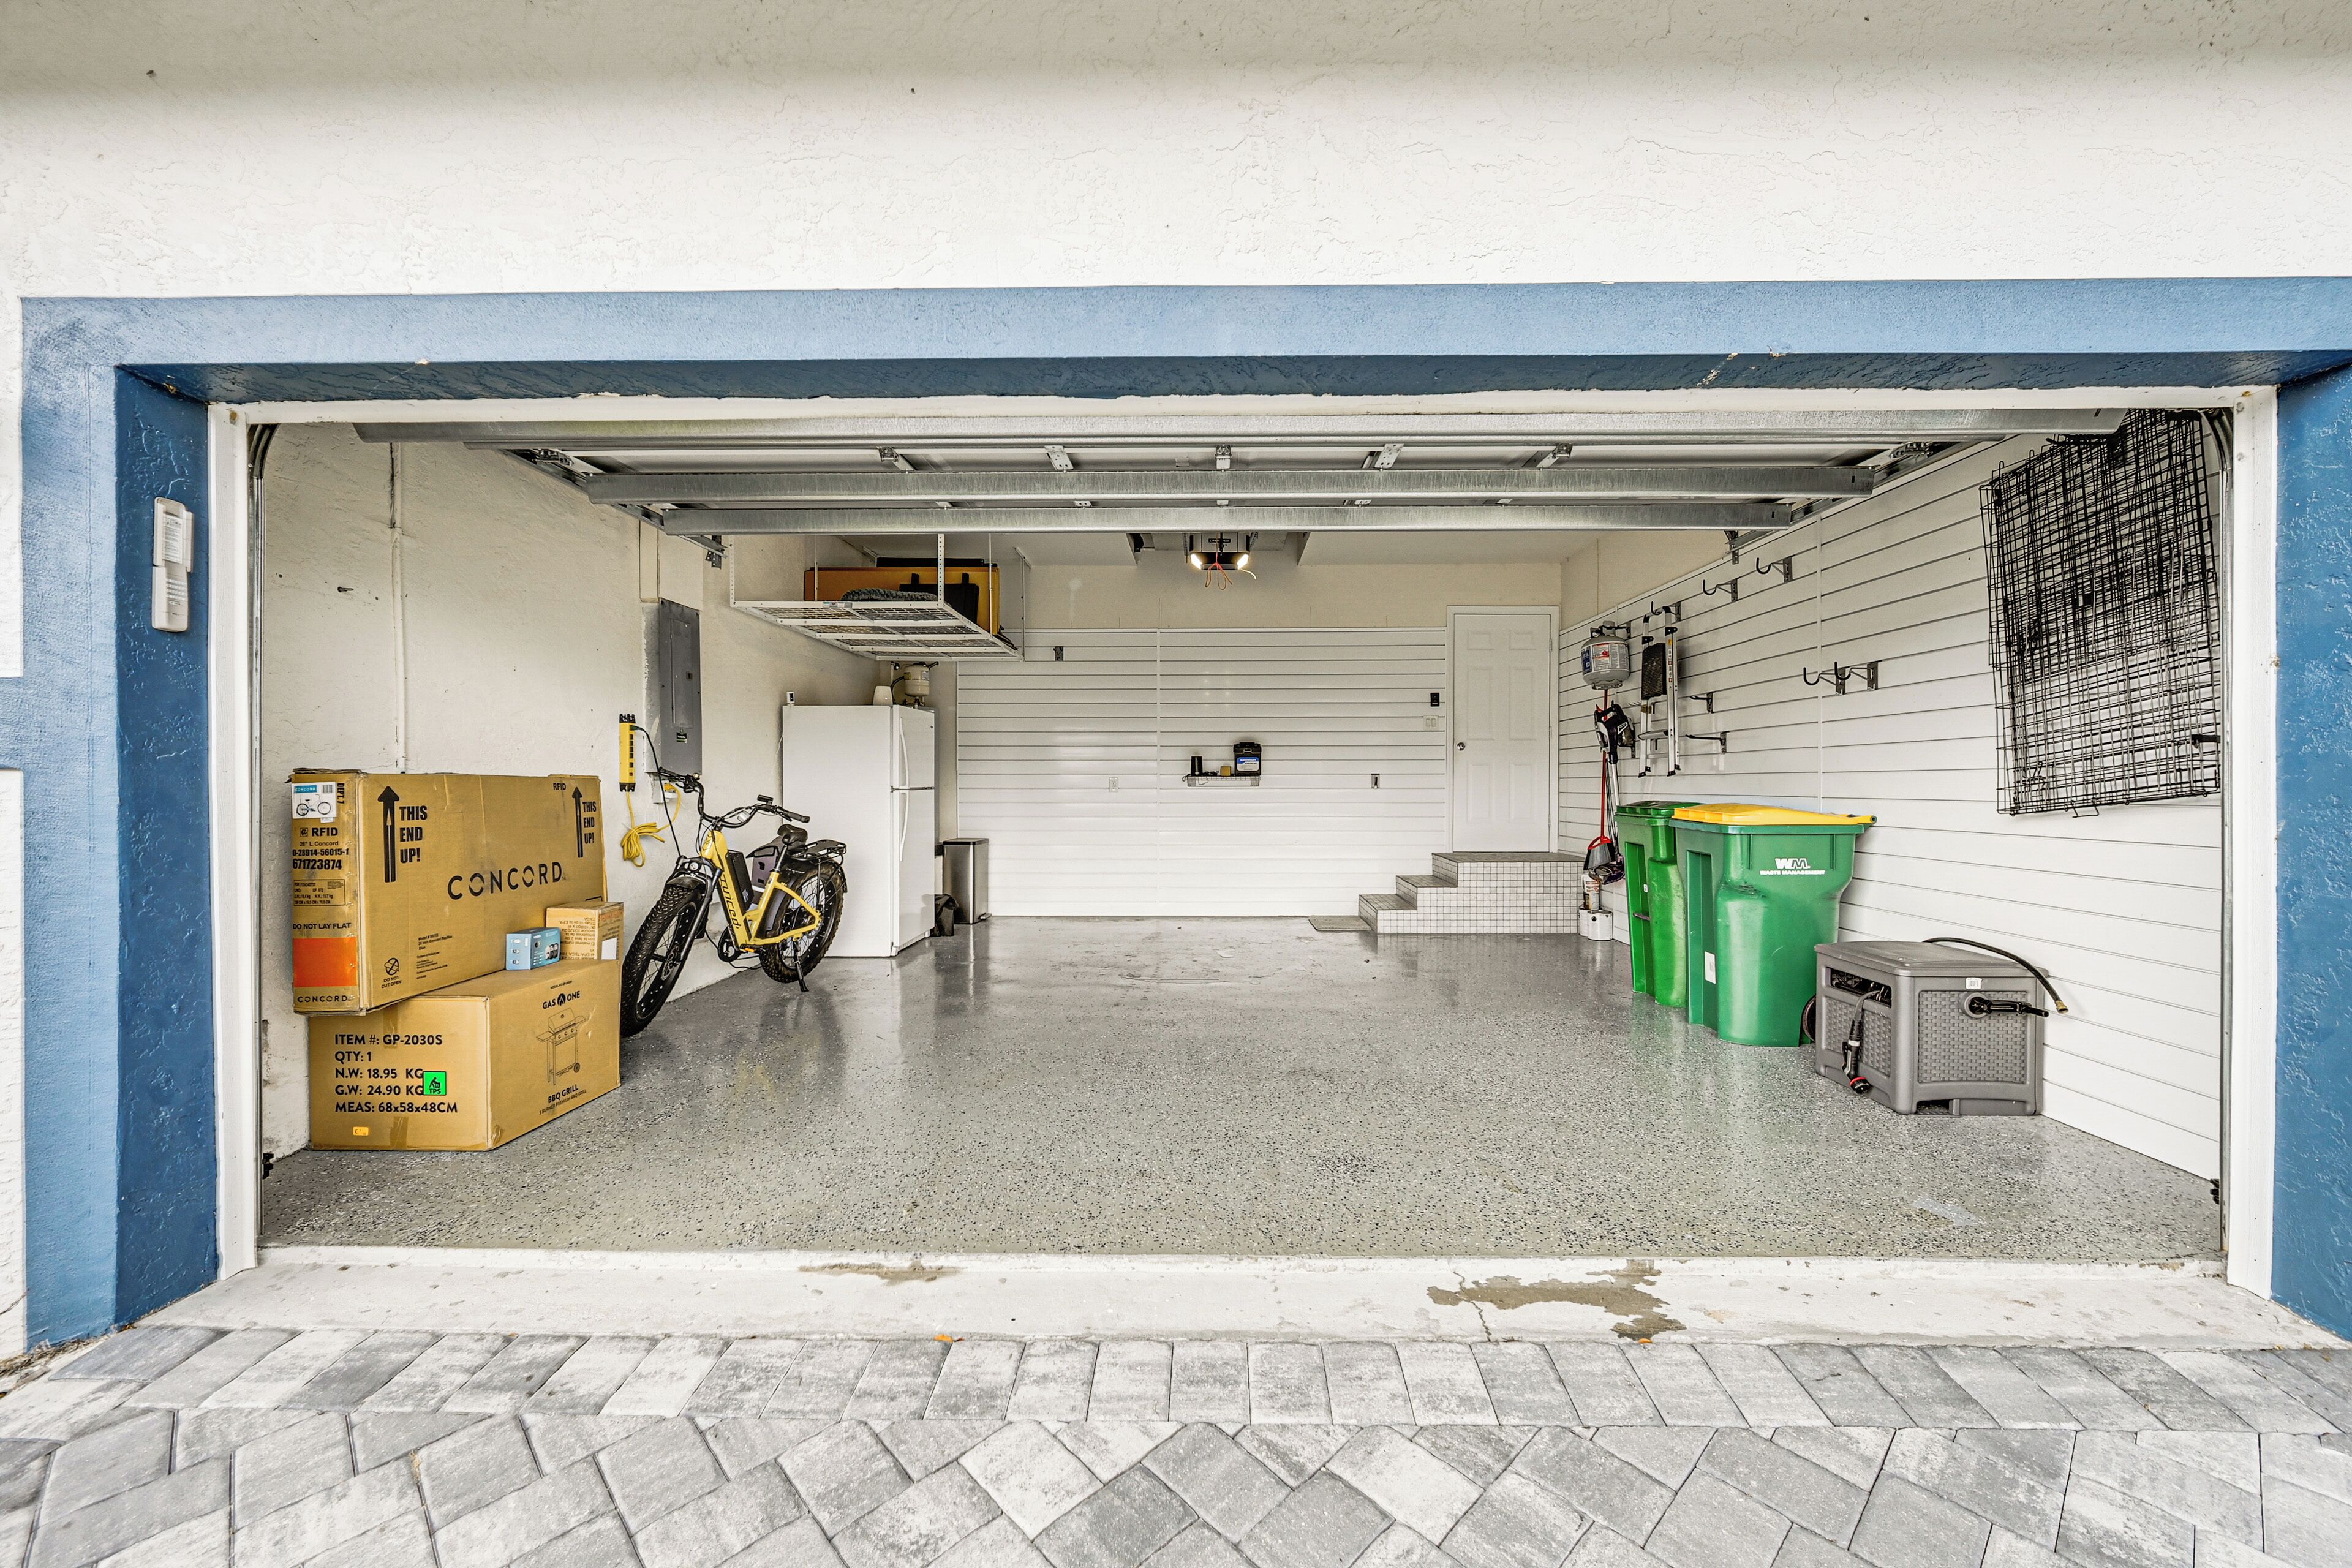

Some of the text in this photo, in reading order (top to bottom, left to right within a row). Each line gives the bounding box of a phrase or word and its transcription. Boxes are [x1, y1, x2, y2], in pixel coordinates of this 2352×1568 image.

[582, 801, 597, 812] THIS
[399, 805, 428, 821] THIS
[583, 817, 595, 828] END
[312, 827, 339, 837] RFID
[400, 827, 423, 842] END
[584, 832, 594, 844] UP!
[400, 848, 421, 864] UP!
[293, 858, 342, 870] 671723874
[447, 862, 562, 900] CONCORD
[543, 990, 580, 1009] GAS ONE
[335, 1034, 443, 1045] ITEM #: GP-2030S
[335, 1051, 372, 1065] QTY: 1
[335, 1068, 424, 1079] N.W: 18.95 KG
[335, 1085, 424, 1096] G.W: 24.90 KG
[548, 1084, 578, 1103] BBQ GRILL
[335, 1102, 458, 1113] MEAS: 68x58x48CM
